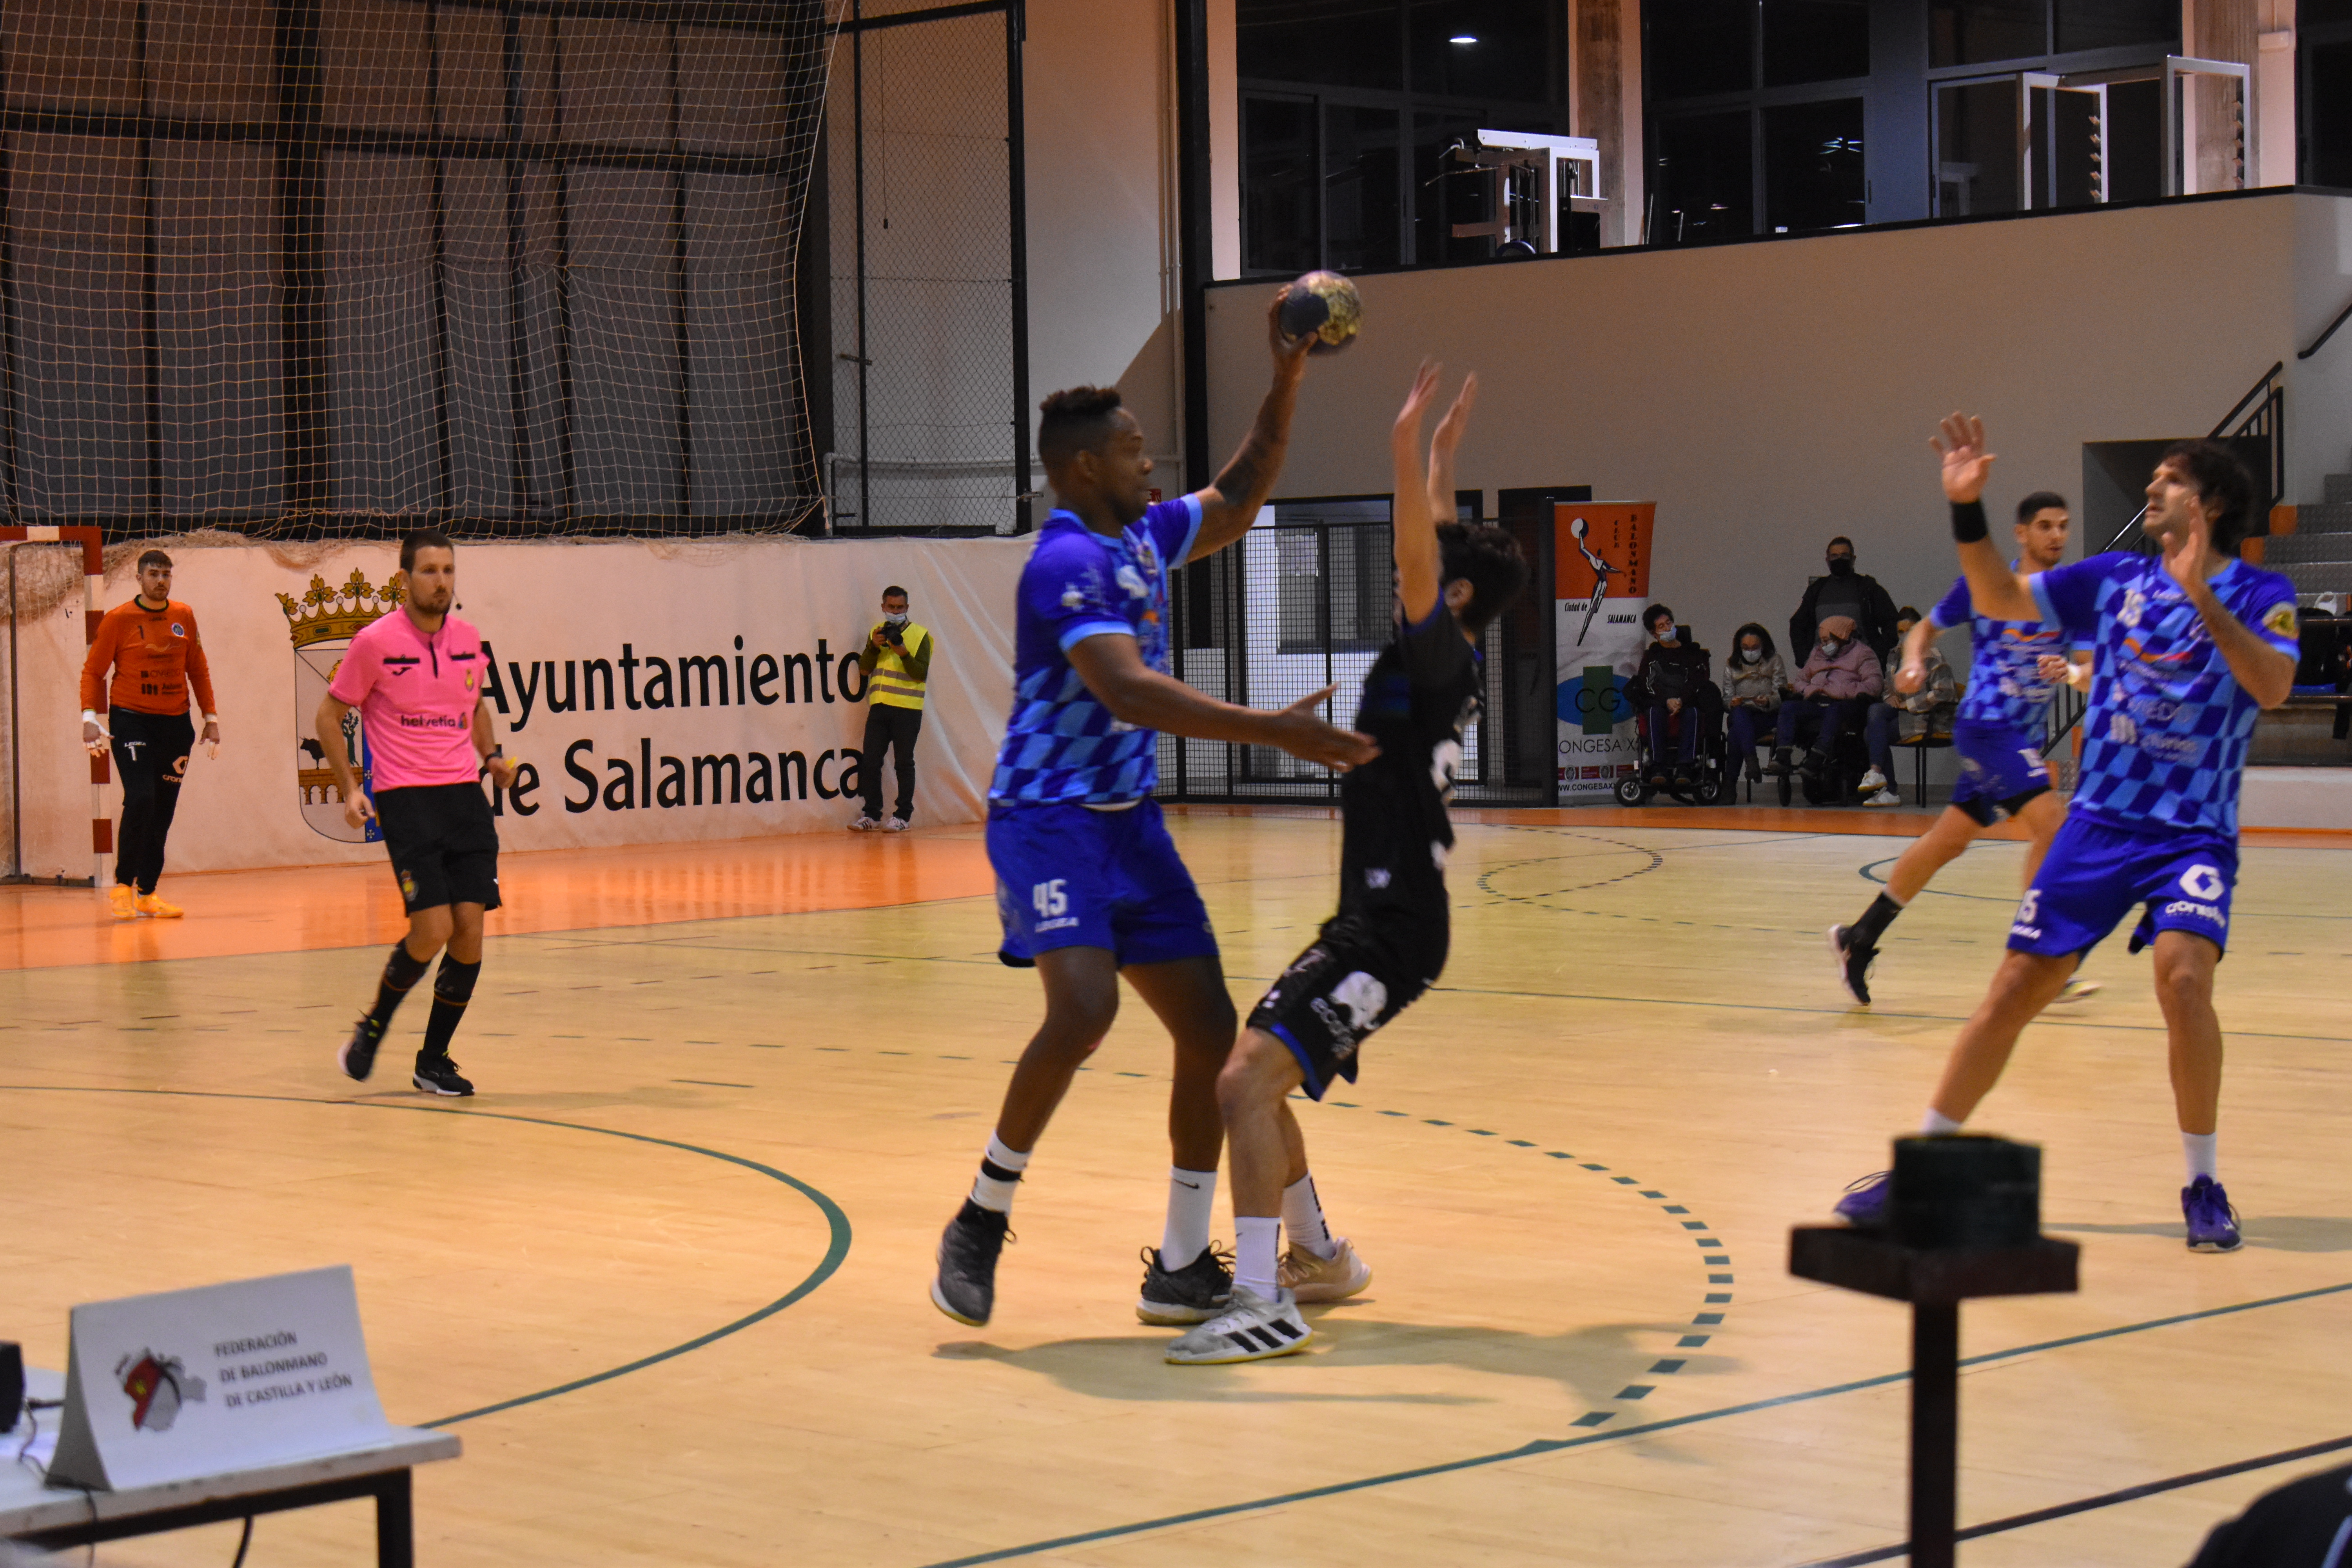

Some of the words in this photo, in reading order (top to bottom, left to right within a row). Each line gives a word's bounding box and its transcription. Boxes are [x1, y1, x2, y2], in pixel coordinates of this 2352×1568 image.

[1628, 514, 1638, 594] BALONMANO
[1564, 602, 1580, 612] Ciudad
[1581, 602, 1588, 612] de
[1607, 614, 1637, 624] SALAMANCA
[137, 625, 144, 640] 1
[481, 635, 868, 732] Ayuntamiento
[1575, 687, 1620, 713] CG
[1559, 739, 1622, 753] ONGESA
[1627, 738, 1635, 751] X
[564, 737, 864, 813] Salamanca
[1033, 878, 1068, 918] 45
[214, 1330, 298, 1357] FEDERACIÓN
[220, 1366, 236, 1383] DE
[241, 1352, 328, 1379] BALONMANO
[226, 1392, 241, 1408] DE
[247, 1382, 306, 1404] CASTILLA
[306, 1379, 315, 1393] Y
[319, 1371, 352, 1391] LEÓN
